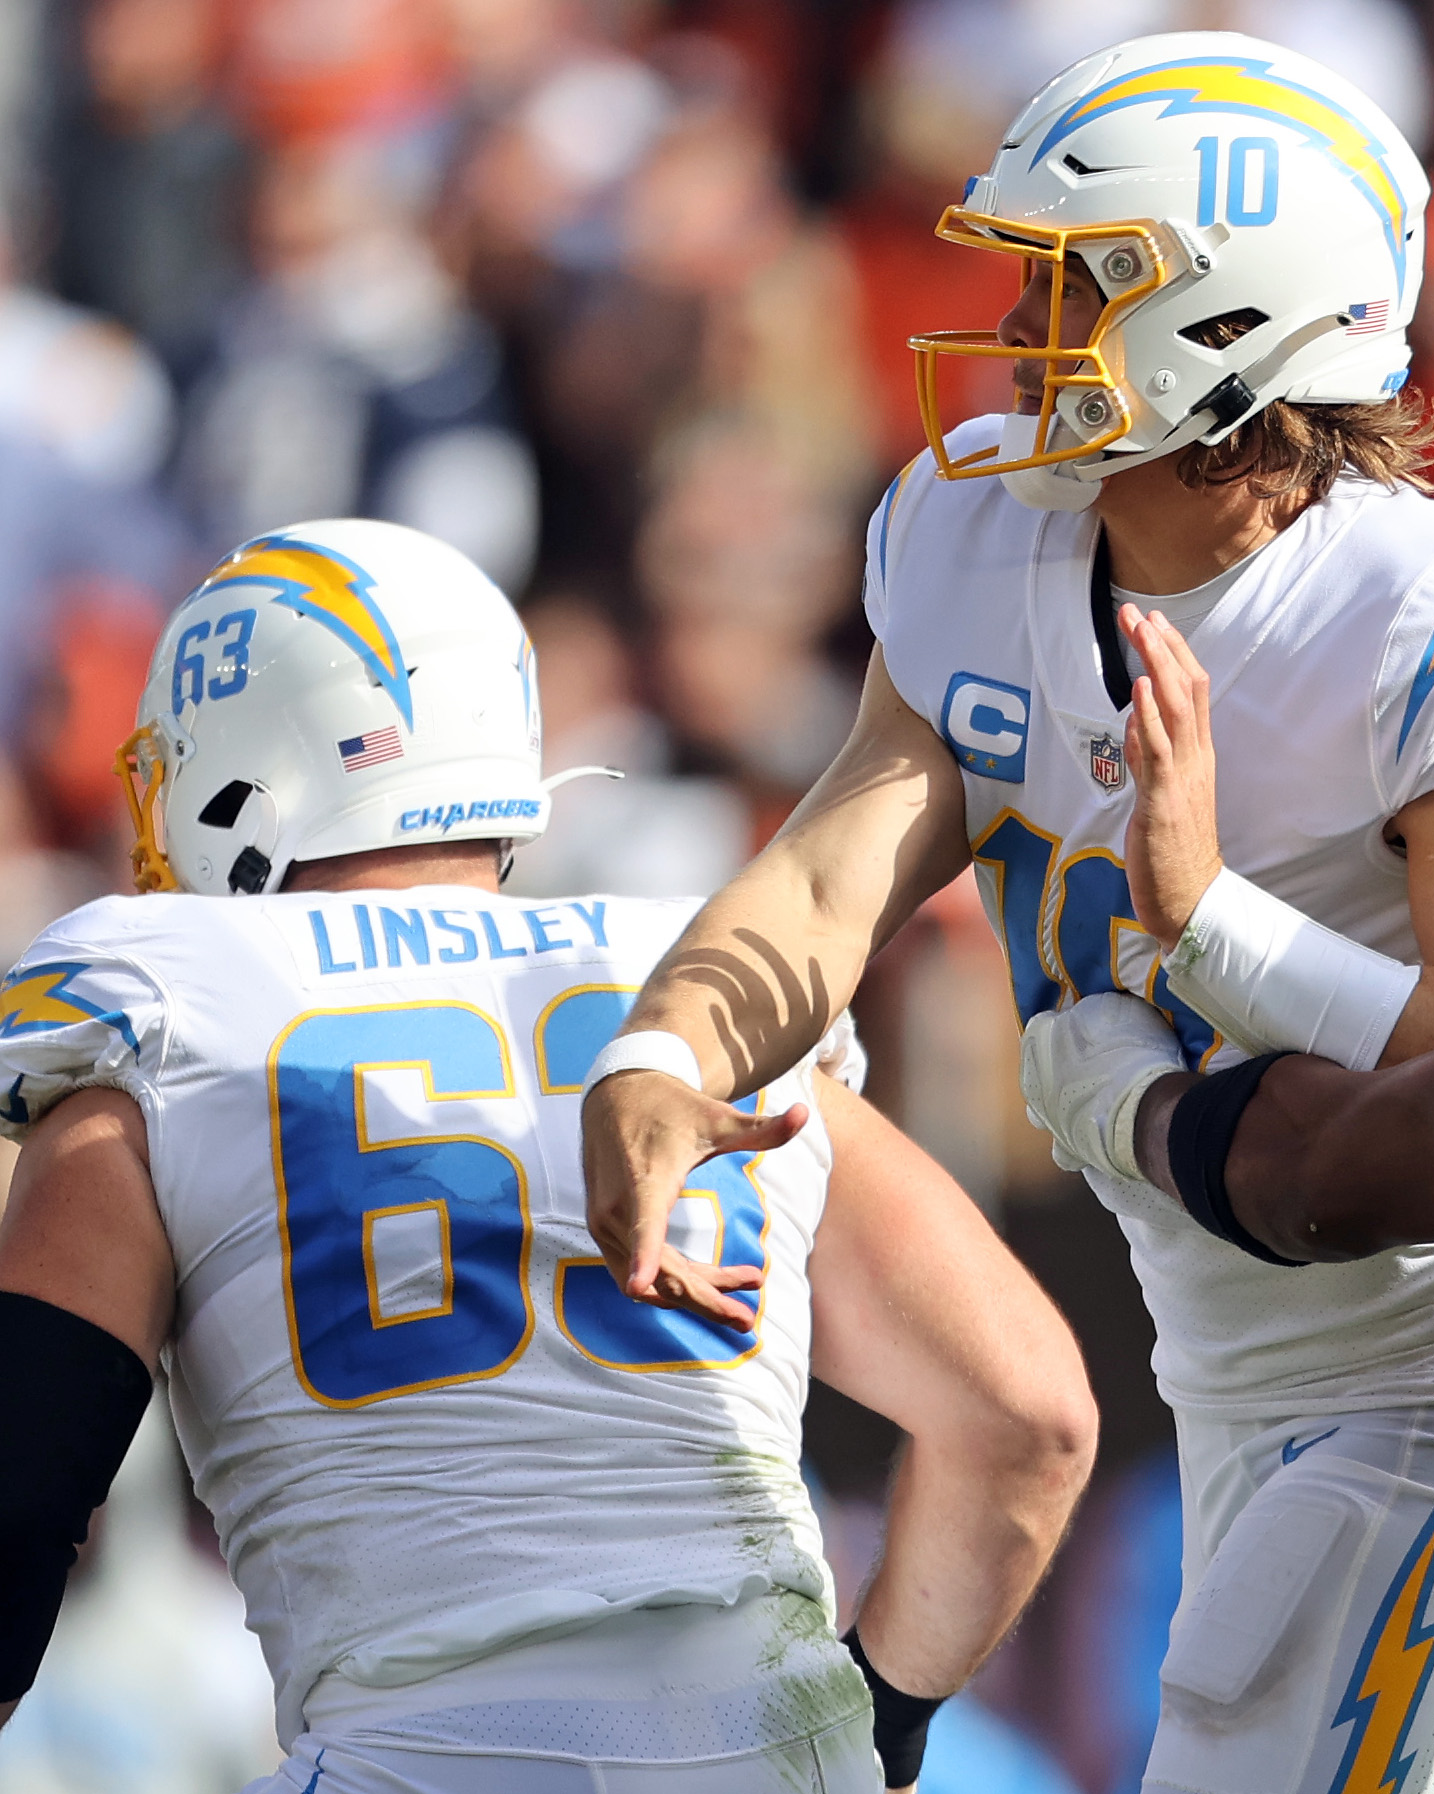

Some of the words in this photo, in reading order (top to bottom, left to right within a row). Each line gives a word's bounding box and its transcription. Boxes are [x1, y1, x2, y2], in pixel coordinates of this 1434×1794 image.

[1192, 136, 1279, 227] 10
[172, 608, 257, 716] 63
[948, 682, 1027, 758] C
[1093, 756, 1119, 784] NFL
[400, 798, 541, 835] CHARGERS
[308, 900, 610, 975] LINSLEY
